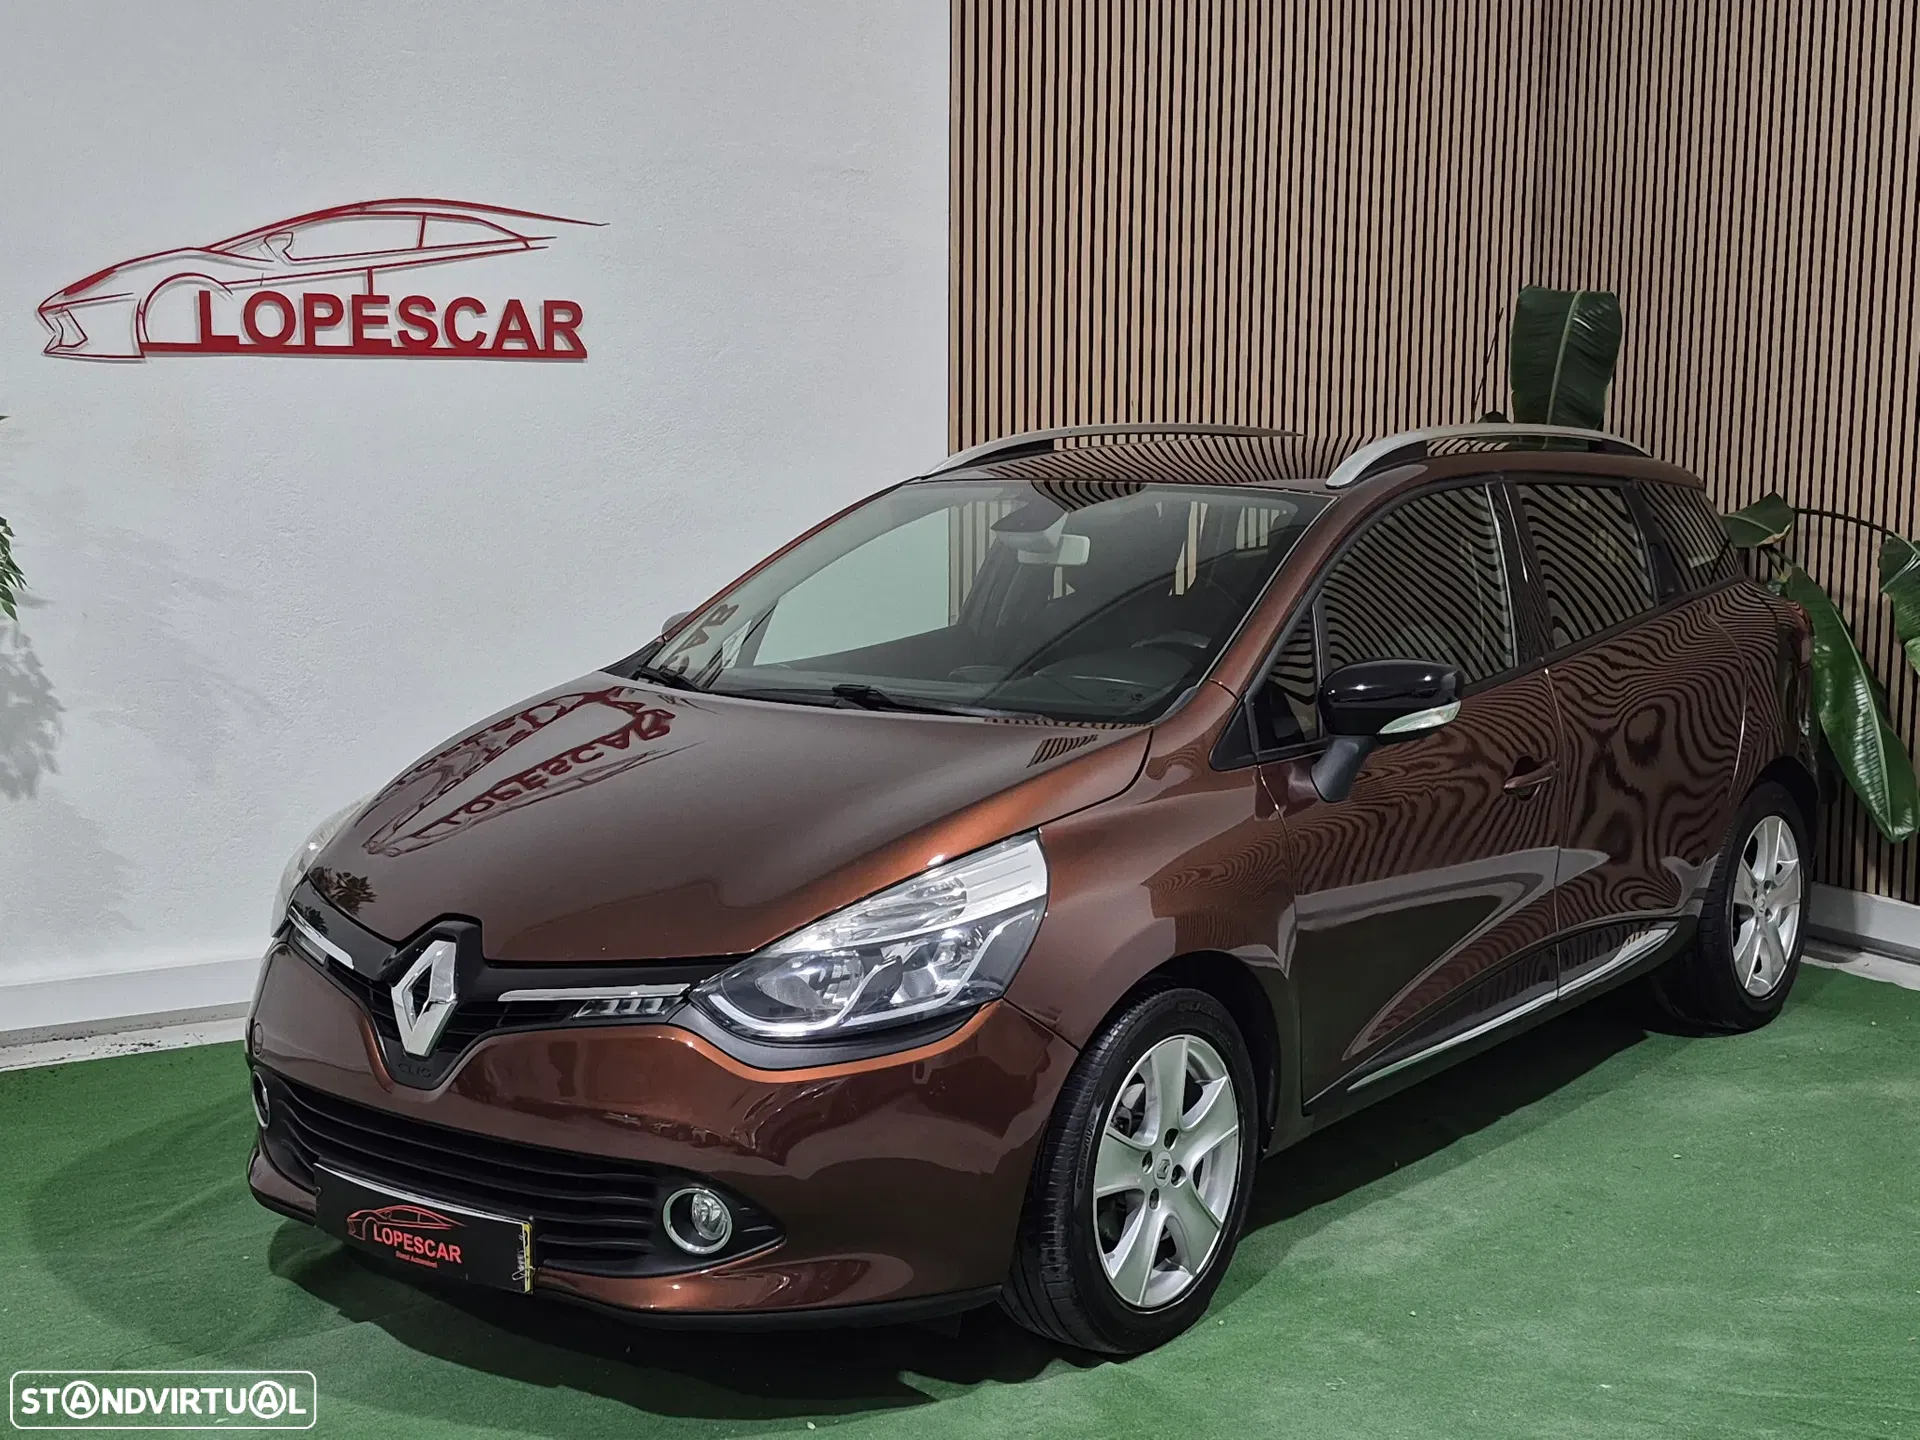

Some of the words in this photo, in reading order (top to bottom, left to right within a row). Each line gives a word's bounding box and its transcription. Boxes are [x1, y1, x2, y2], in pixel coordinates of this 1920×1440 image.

[199, 288, 588, 358] LOPESCAR
[398, 1064, 432, 1078] CLIO
[373, 1224, 462, 1264] LOPESCAR
